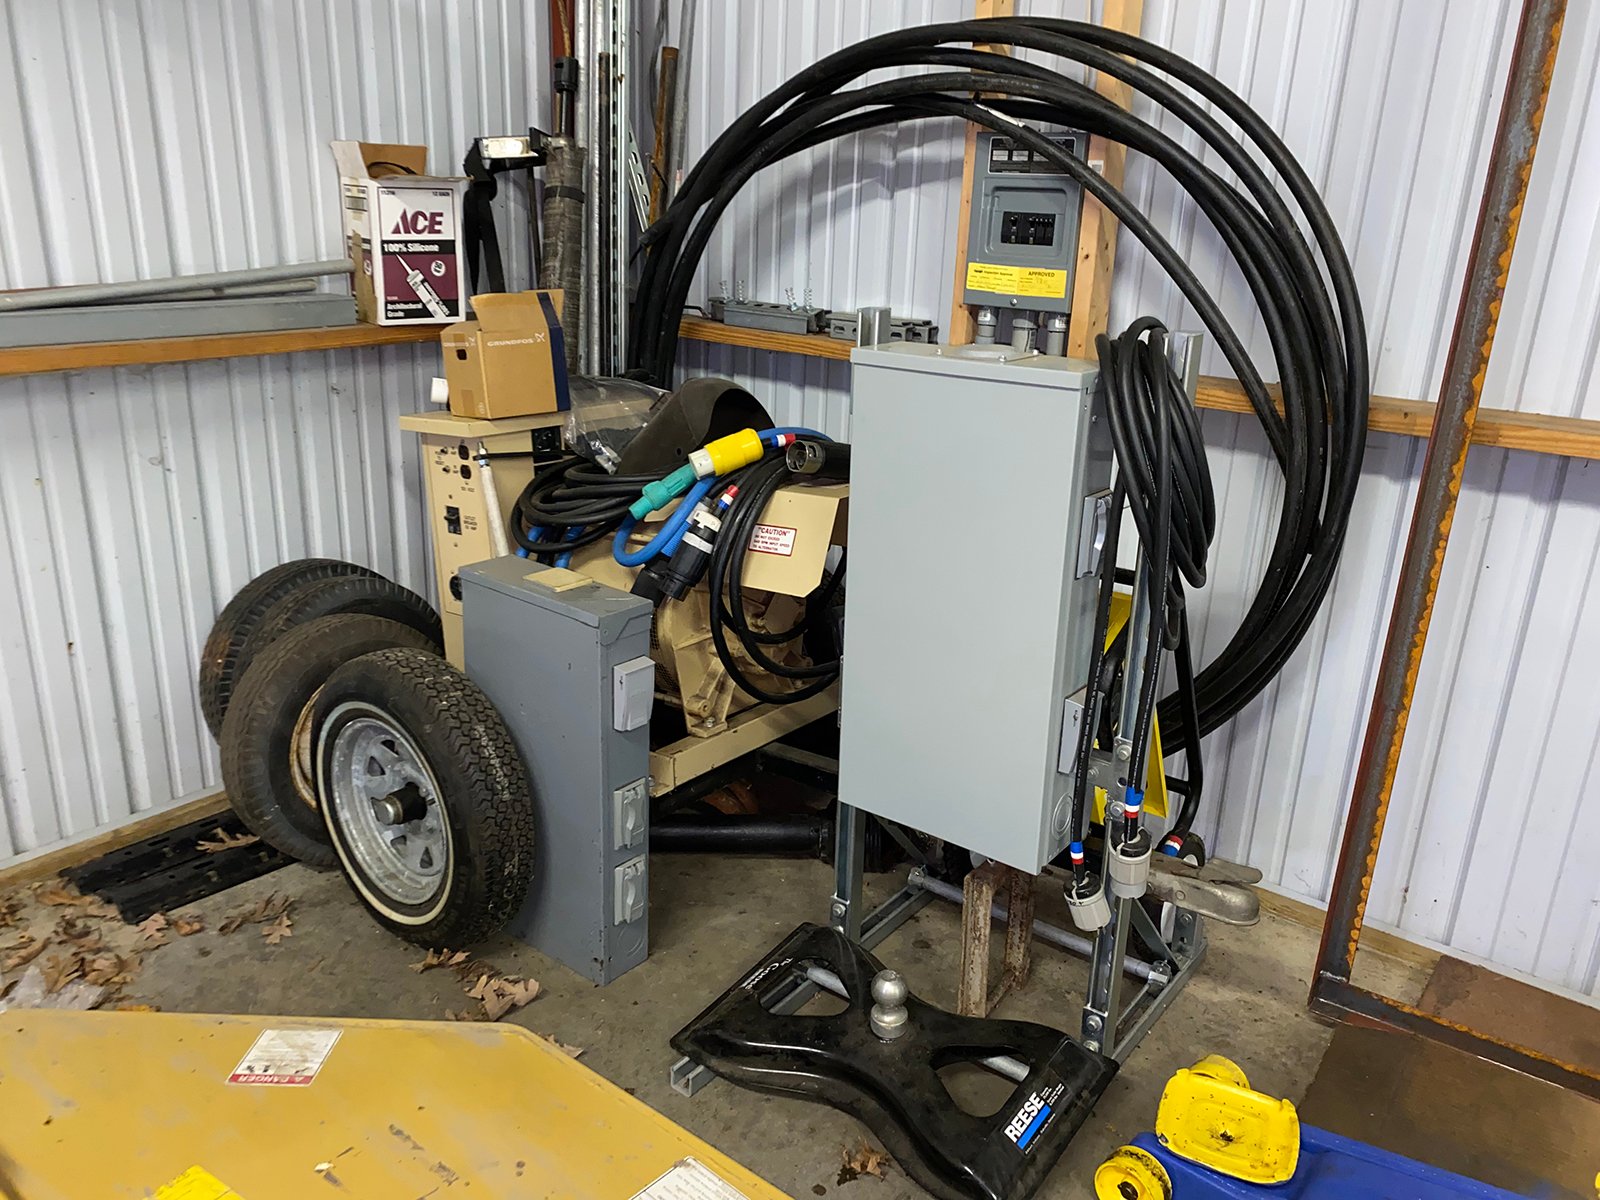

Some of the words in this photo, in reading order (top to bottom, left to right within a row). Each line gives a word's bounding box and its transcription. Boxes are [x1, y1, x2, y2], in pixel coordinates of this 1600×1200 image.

[391, 208, 444, 234] ACE
[383, 243, 407, 252] 100%
[407, 243, 439, 252] Silicone
[487, 338, 534, 346] GRUNDFOS
[1004, 1091, 1045, 1144] REESE
